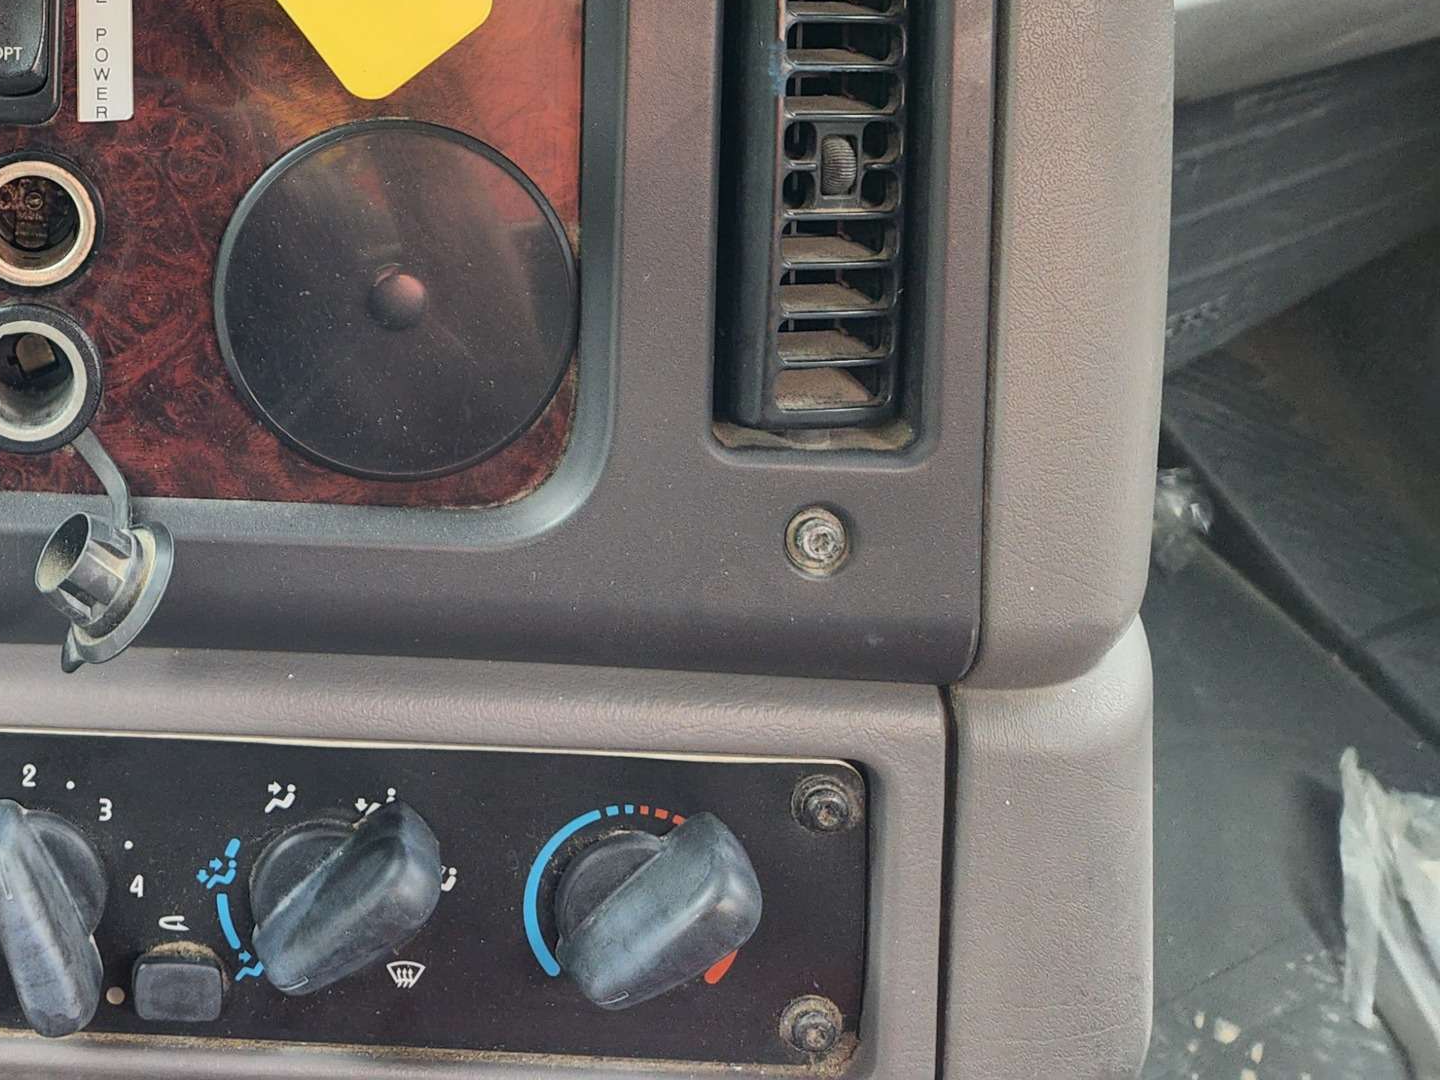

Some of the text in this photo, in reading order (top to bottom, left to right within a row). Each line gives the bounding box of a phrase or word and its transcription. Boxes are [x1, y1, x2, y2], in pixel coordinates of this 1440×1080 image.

[93, 27, 110, 119] POWER
[22, 764, 37, 788] 2
[98, 798, 113, 822] 3
[129, 874, 145, 899] 4
